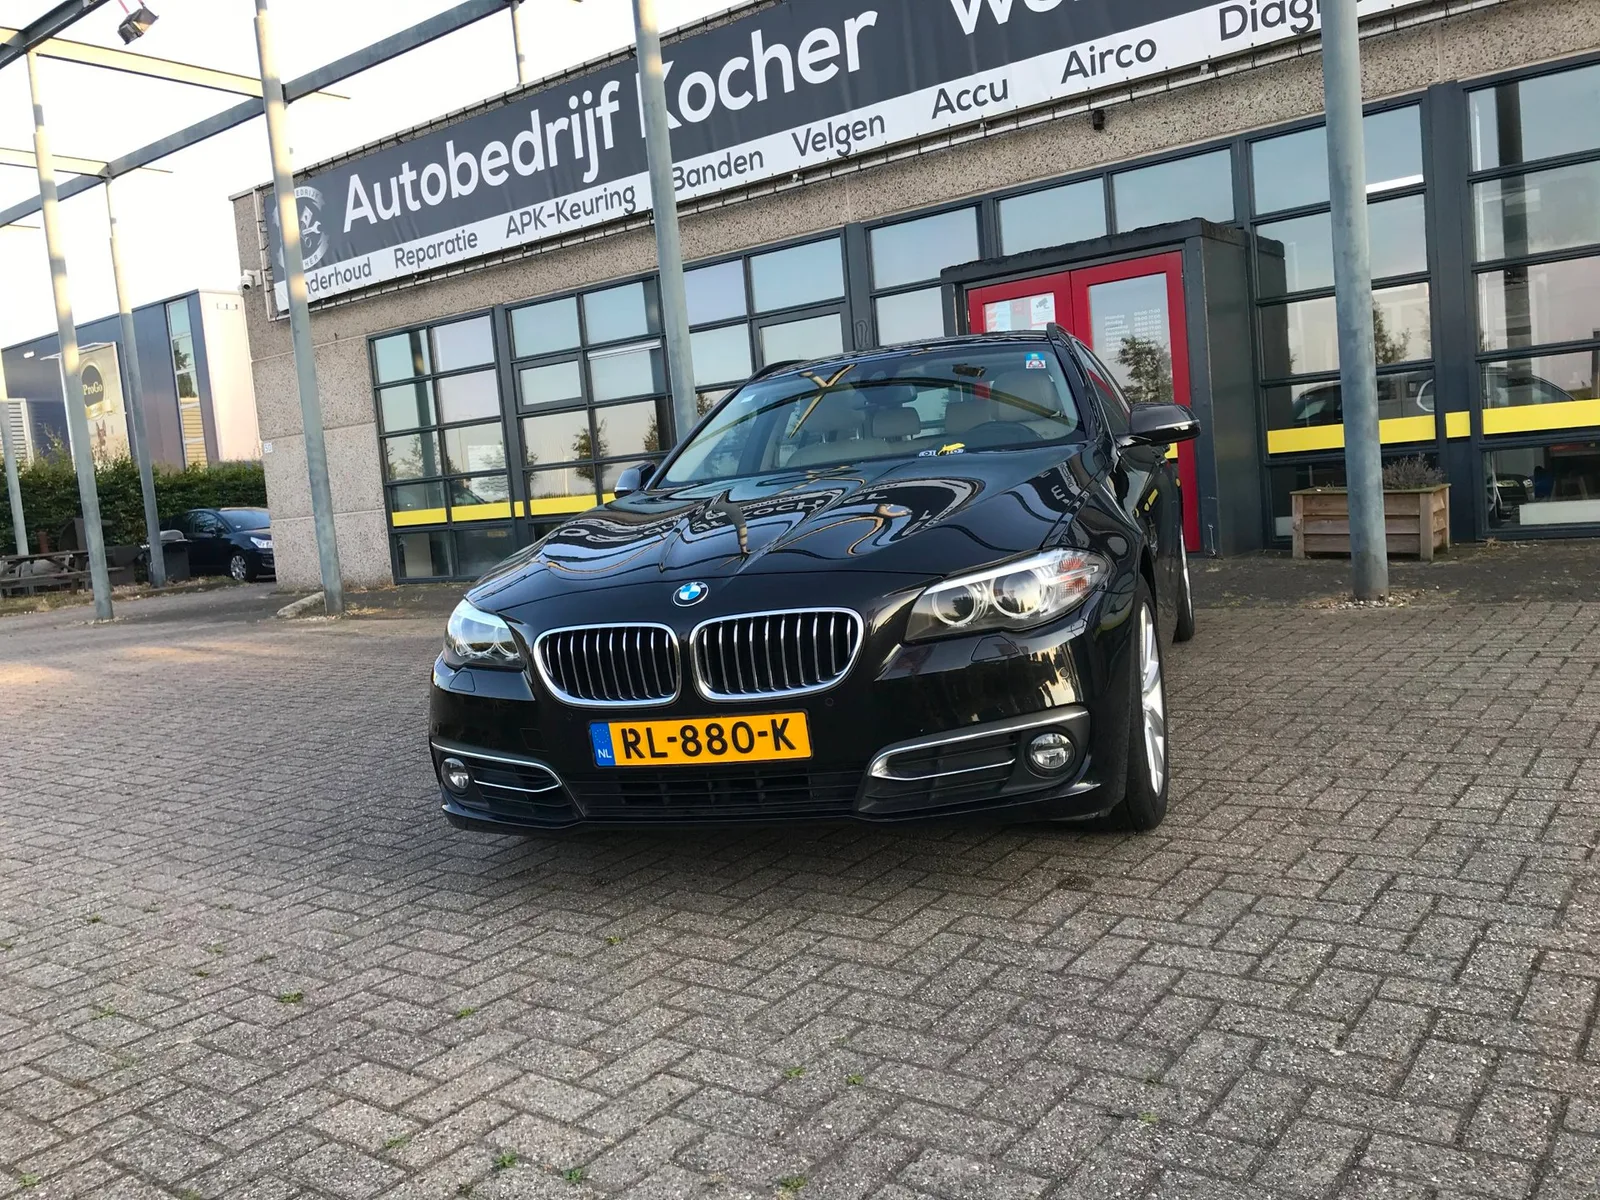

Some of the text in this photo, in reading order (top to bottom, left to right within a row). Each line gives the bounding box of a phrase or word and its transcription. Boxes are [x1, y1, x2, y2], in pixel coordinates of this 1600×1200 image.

[343, 80, 621, 233] Autobedrijf
[394, 230, 478, 269] Reparatie
[505, 184, 637, 240] APK-Keuring
[672, 150, 764, 191] Banden
[791, 114, 885, 157] Velgen
[931, 76, 1010, 120] Accu
[1060, 38, 1158, 85] Airco
[597, 748, 612, 759] NL
[620, 718, 796, 759] RL-880-K
